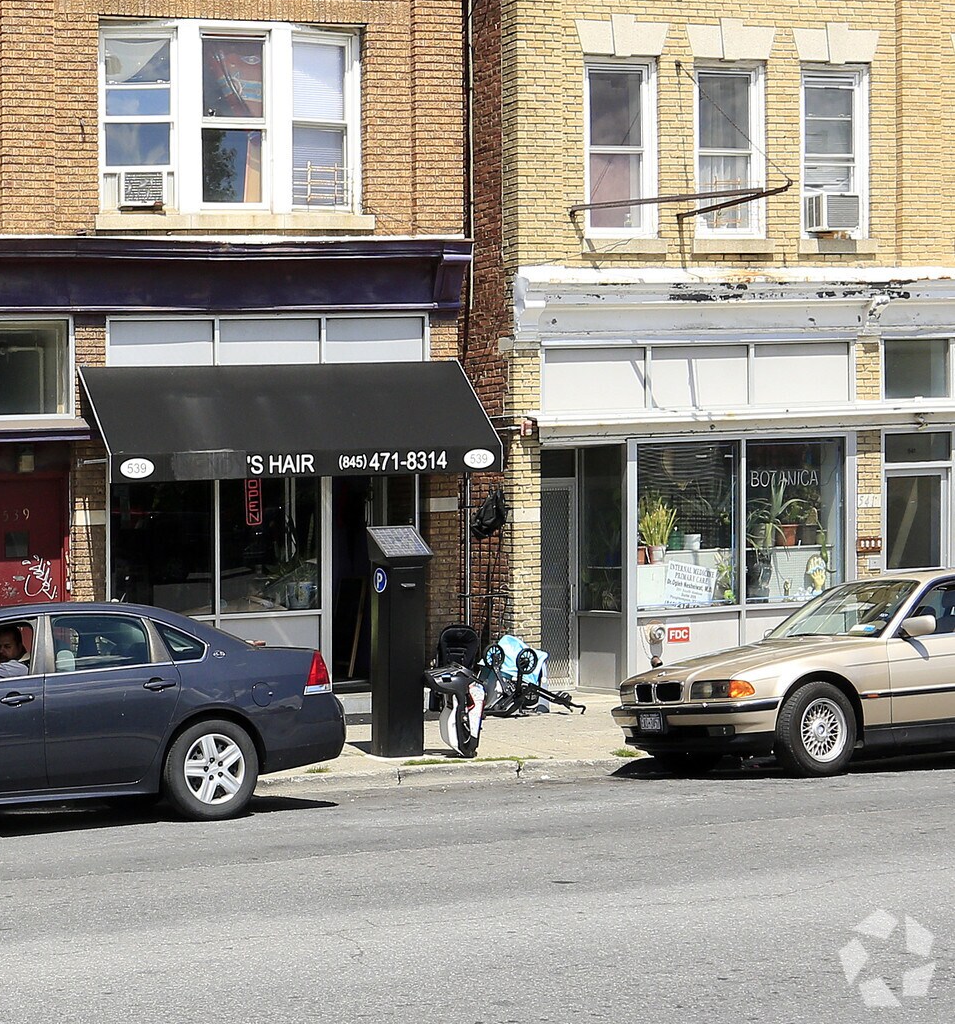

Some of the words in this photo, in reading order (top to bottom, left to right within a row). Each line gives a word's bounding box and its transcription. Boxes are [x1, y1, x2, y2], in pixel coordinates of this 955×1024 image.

[268, 454, 315, 474] HAIR
[338, 454, 368, 470] (845)
[369, 451, 448, 471] 471-8314
[469, 453, 488, 465] 539
[126, 463, 147, 474] 539
[750, 469, 819, 487] BOTANICA
[248, 479, 260, 523] OPEN
[3, 508, 30, 521] 539
[669, 629, 689, 640] FDC
